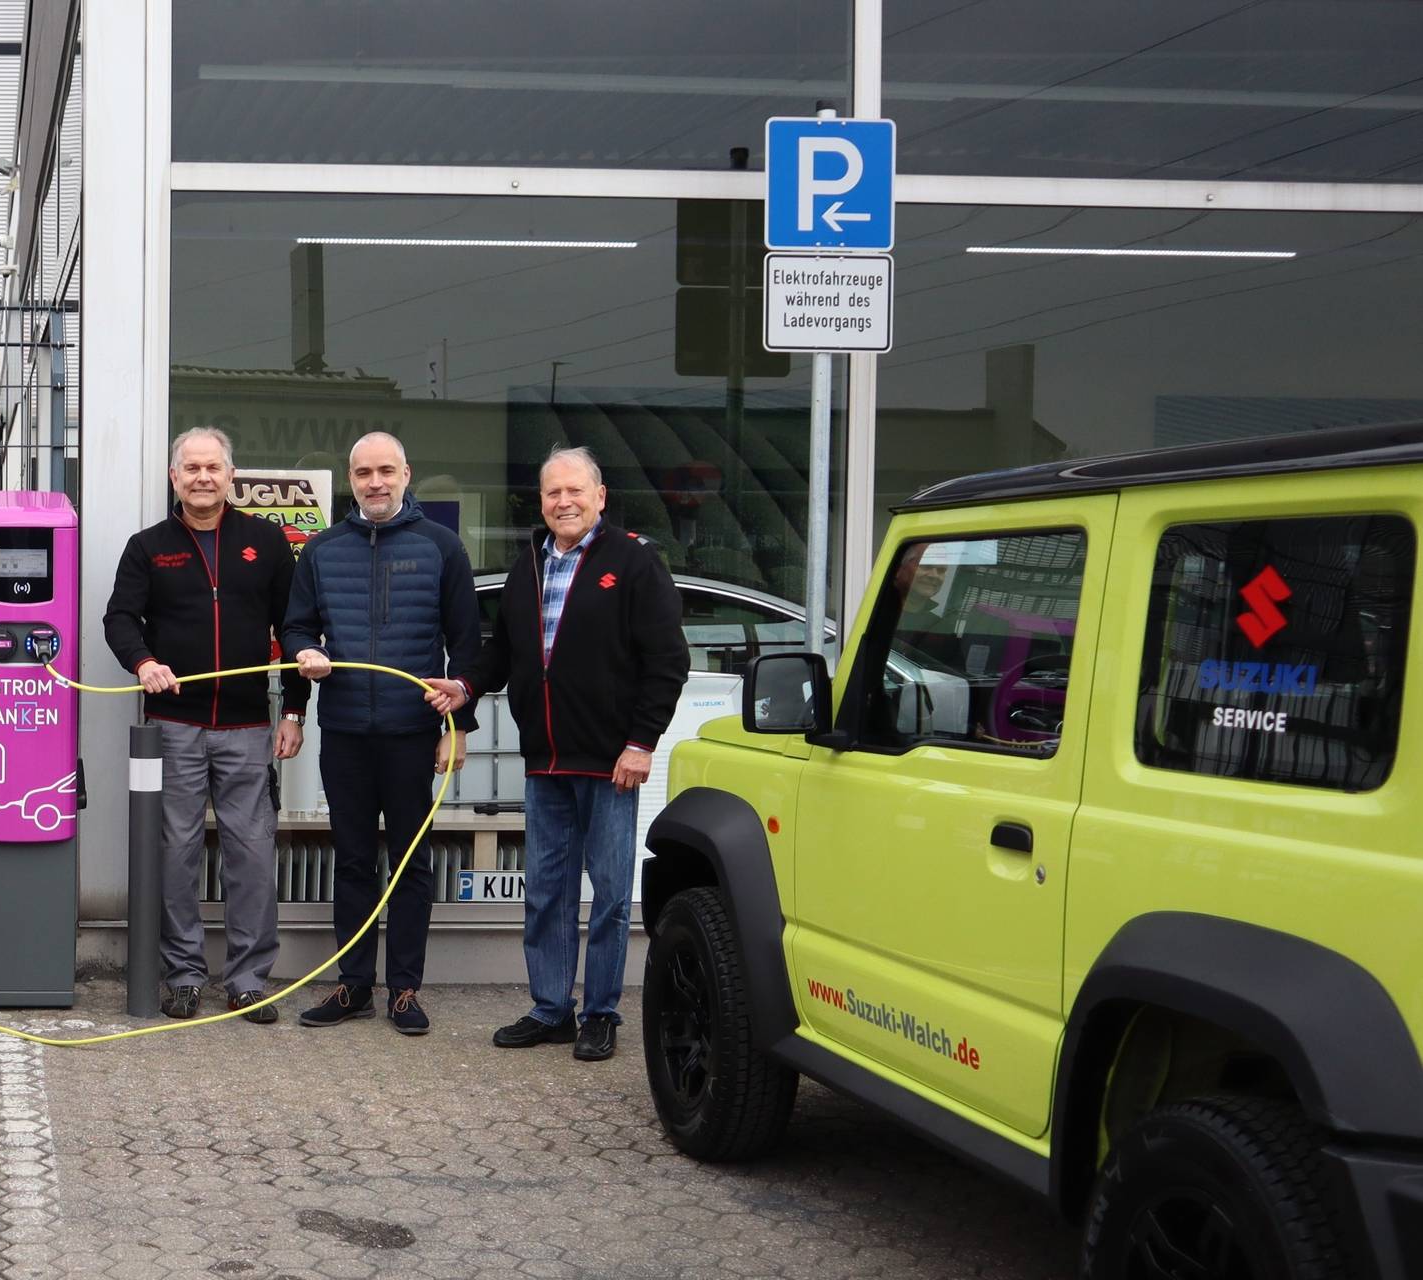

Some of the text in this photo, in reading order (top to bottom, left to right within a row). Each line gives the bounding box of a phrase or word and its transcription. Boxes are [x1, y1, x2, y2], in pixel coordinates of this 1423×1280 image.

[798, 136, 864, 231] P
[773, 269, 883, 290] Elektrofahrzeuge
[785, 291, 870, 308] während des
[783, 312, 872, 332] Ladevorgangs
[1199, 659, 1319, 697] SUZUKI
[1212, 706, 1287, 733] SERVICE
[807, 978, 980, 1070] www.Suzuki-Walch.de
